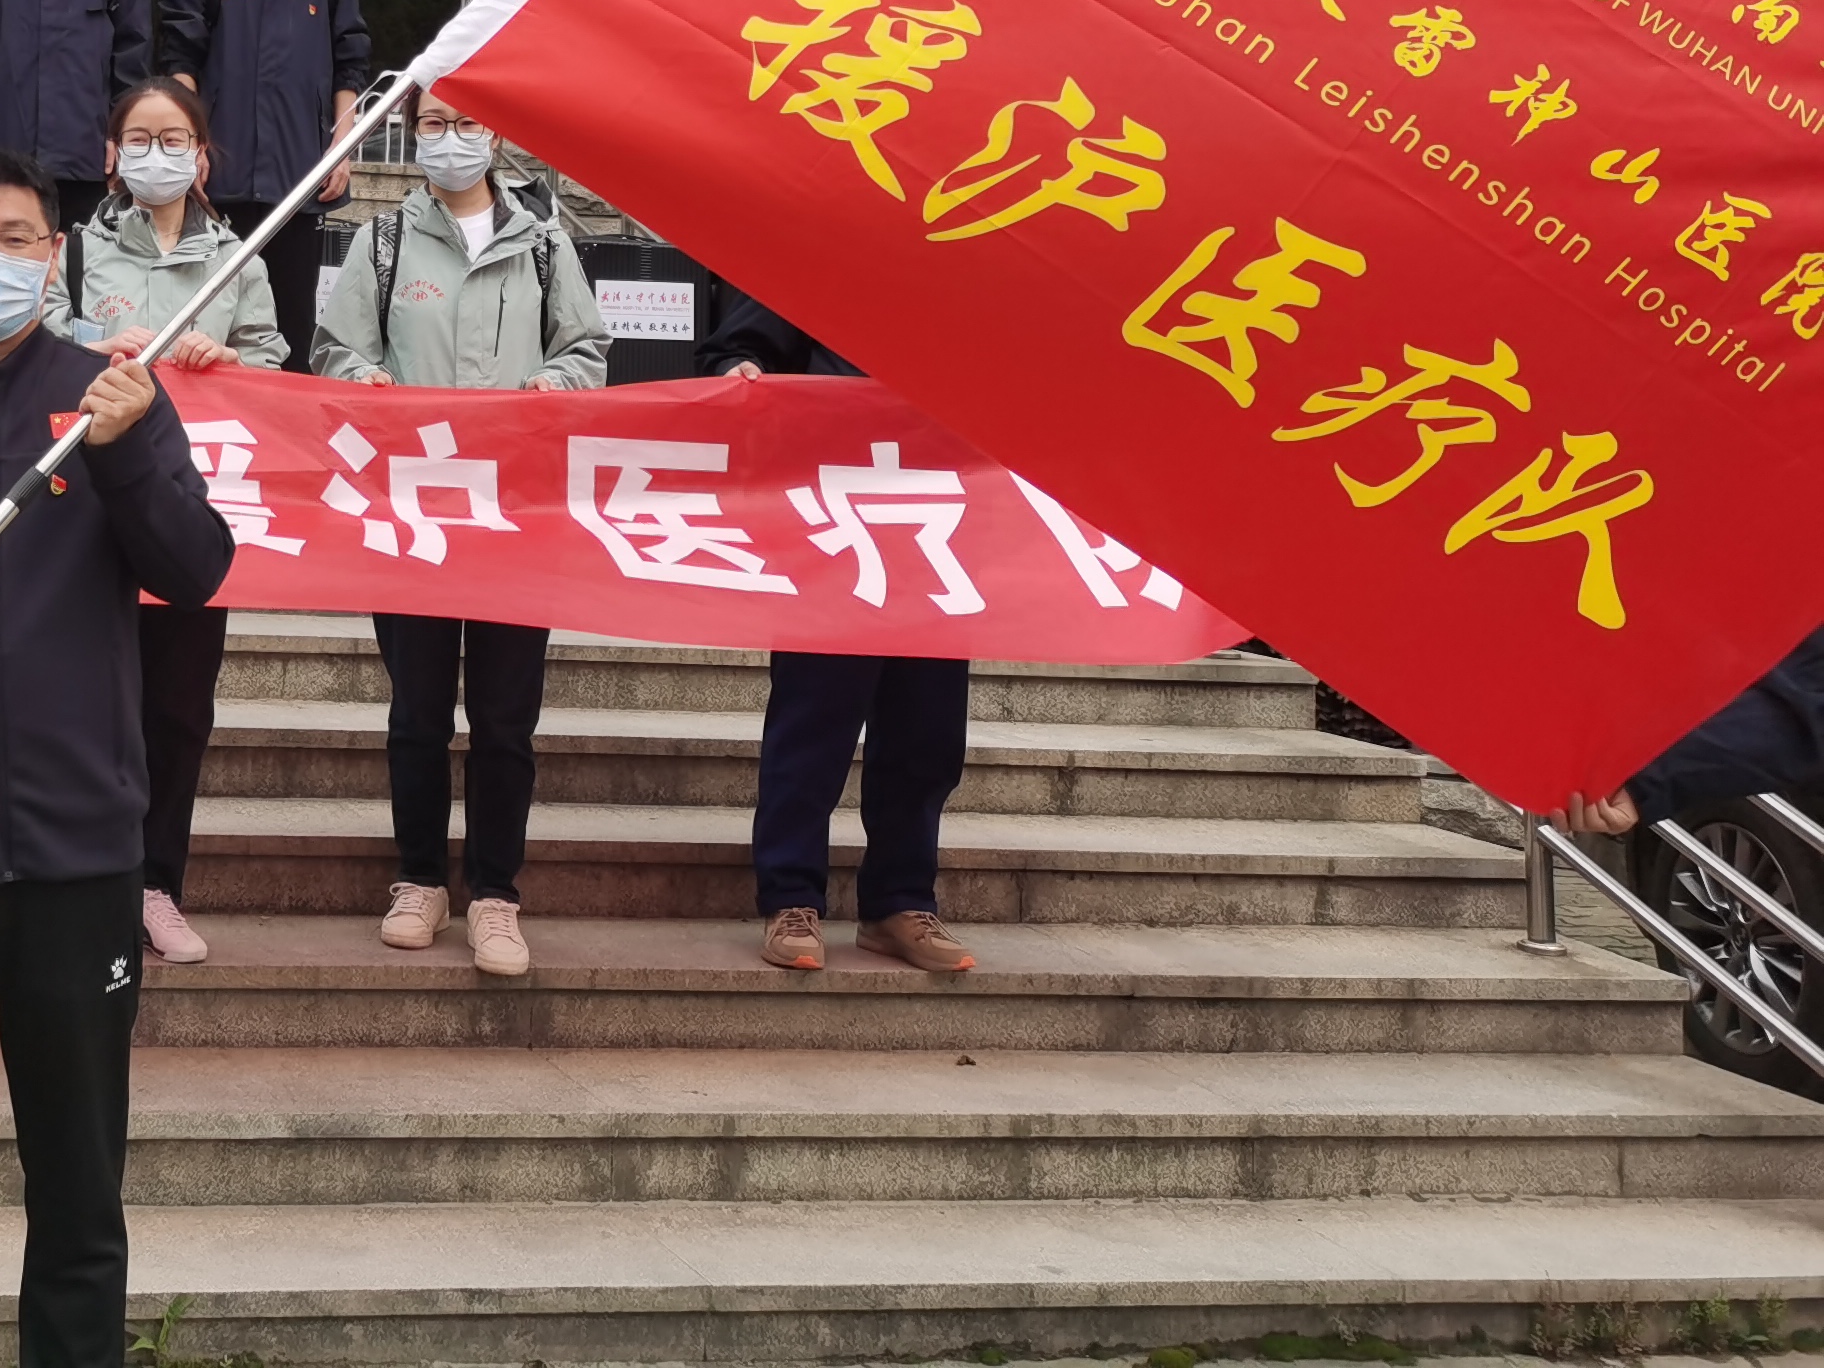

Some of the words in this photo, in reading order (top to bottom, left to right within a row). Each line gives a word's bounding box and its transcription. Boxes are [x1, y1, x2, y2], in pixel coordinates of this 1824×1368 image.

[1637, 1, 1762, 96] WUHAN
[1293, 56, 1594, 264] Leishenshan
[1604, 255, 1787, 394] Hospital
[105, 975, 132, 994] KELME
